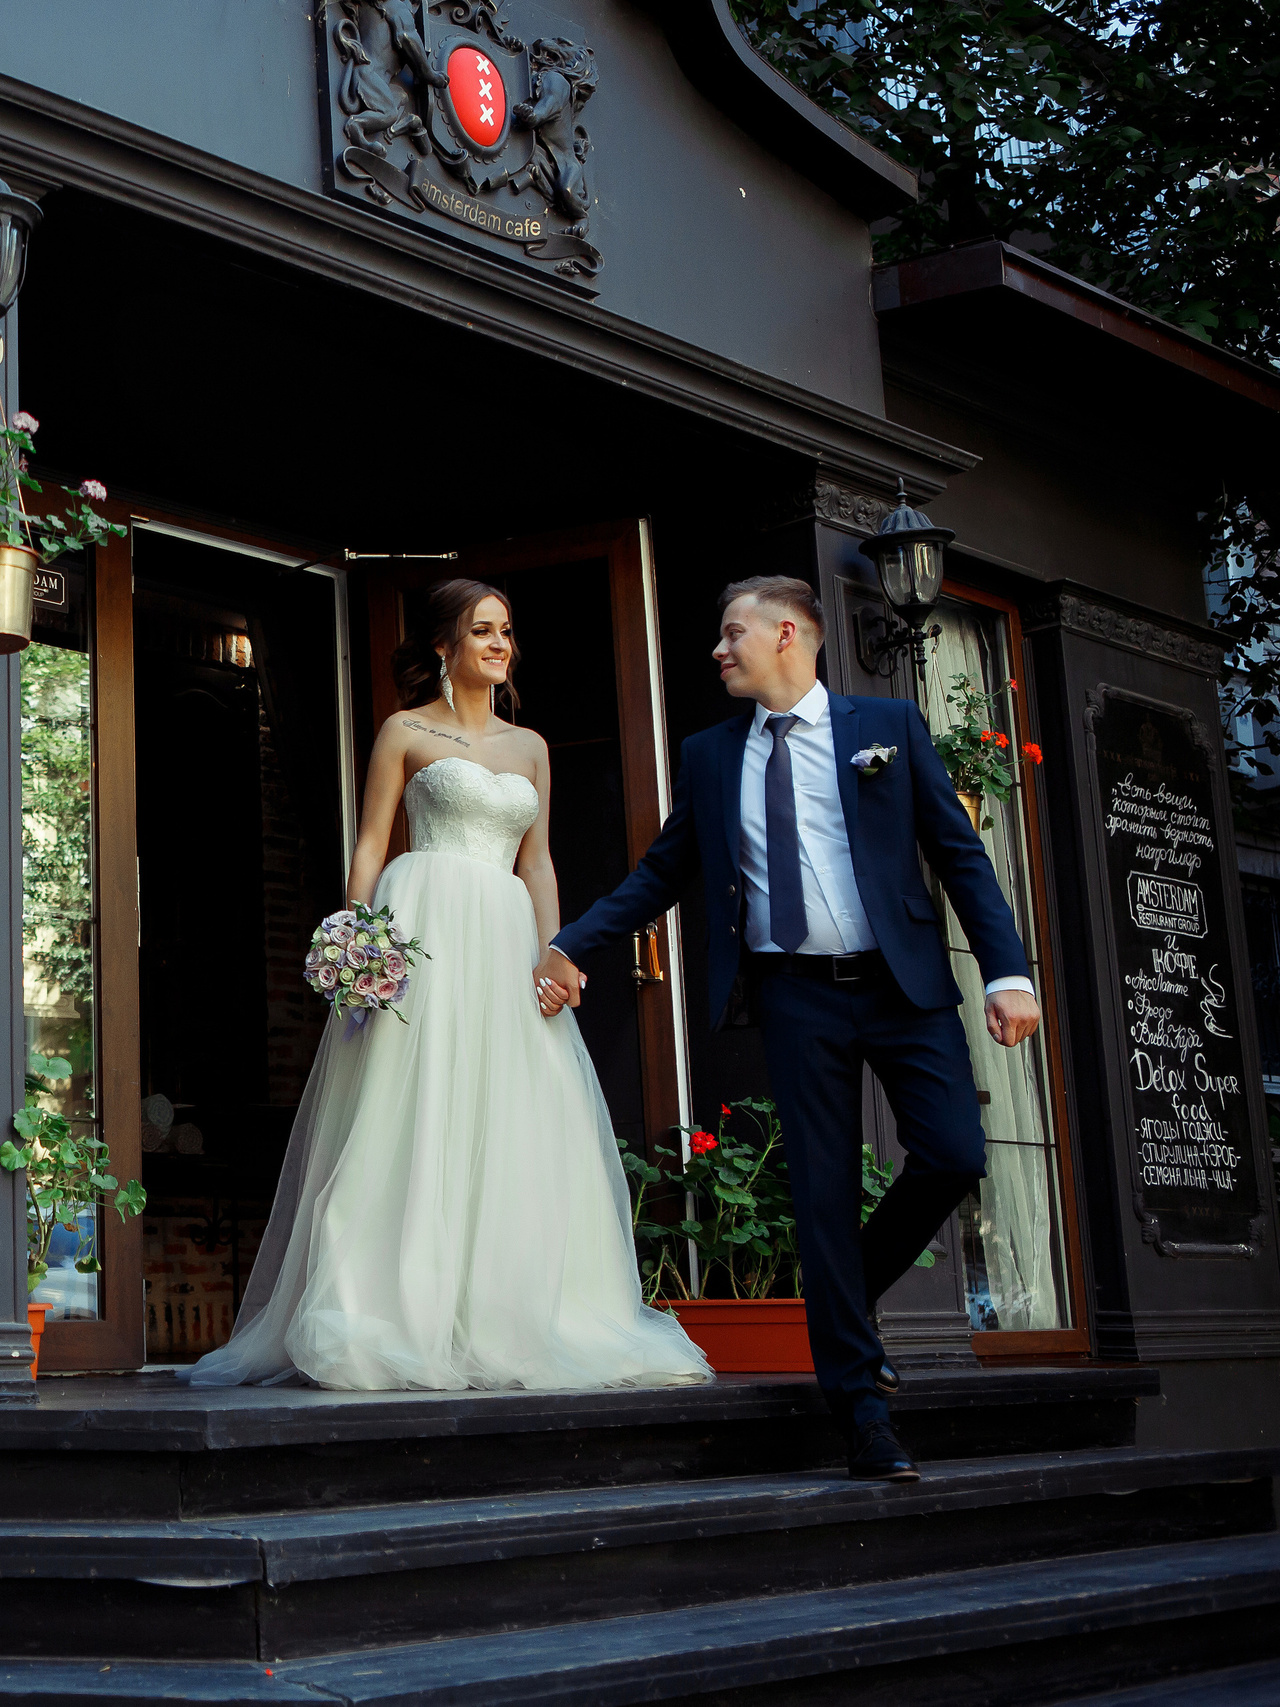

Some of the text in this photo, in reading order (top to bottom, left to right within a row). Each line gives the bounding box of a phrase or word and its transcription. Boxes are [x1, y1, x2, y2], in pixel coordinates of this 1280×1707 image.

[421, 178, 541, 237] amsterdam cafe
[1136, 843, 1201, 877] например
[1137, 877, 1199, 915] AMSTERDAM
[1138, 912, 1200, 933] RESTAURANT GROUP
[1152, 948, 1199, 979] КОФЕ
[1130, 1048, 1187, 1092] Detox
[1171, 1093, 1212, 1121] food
